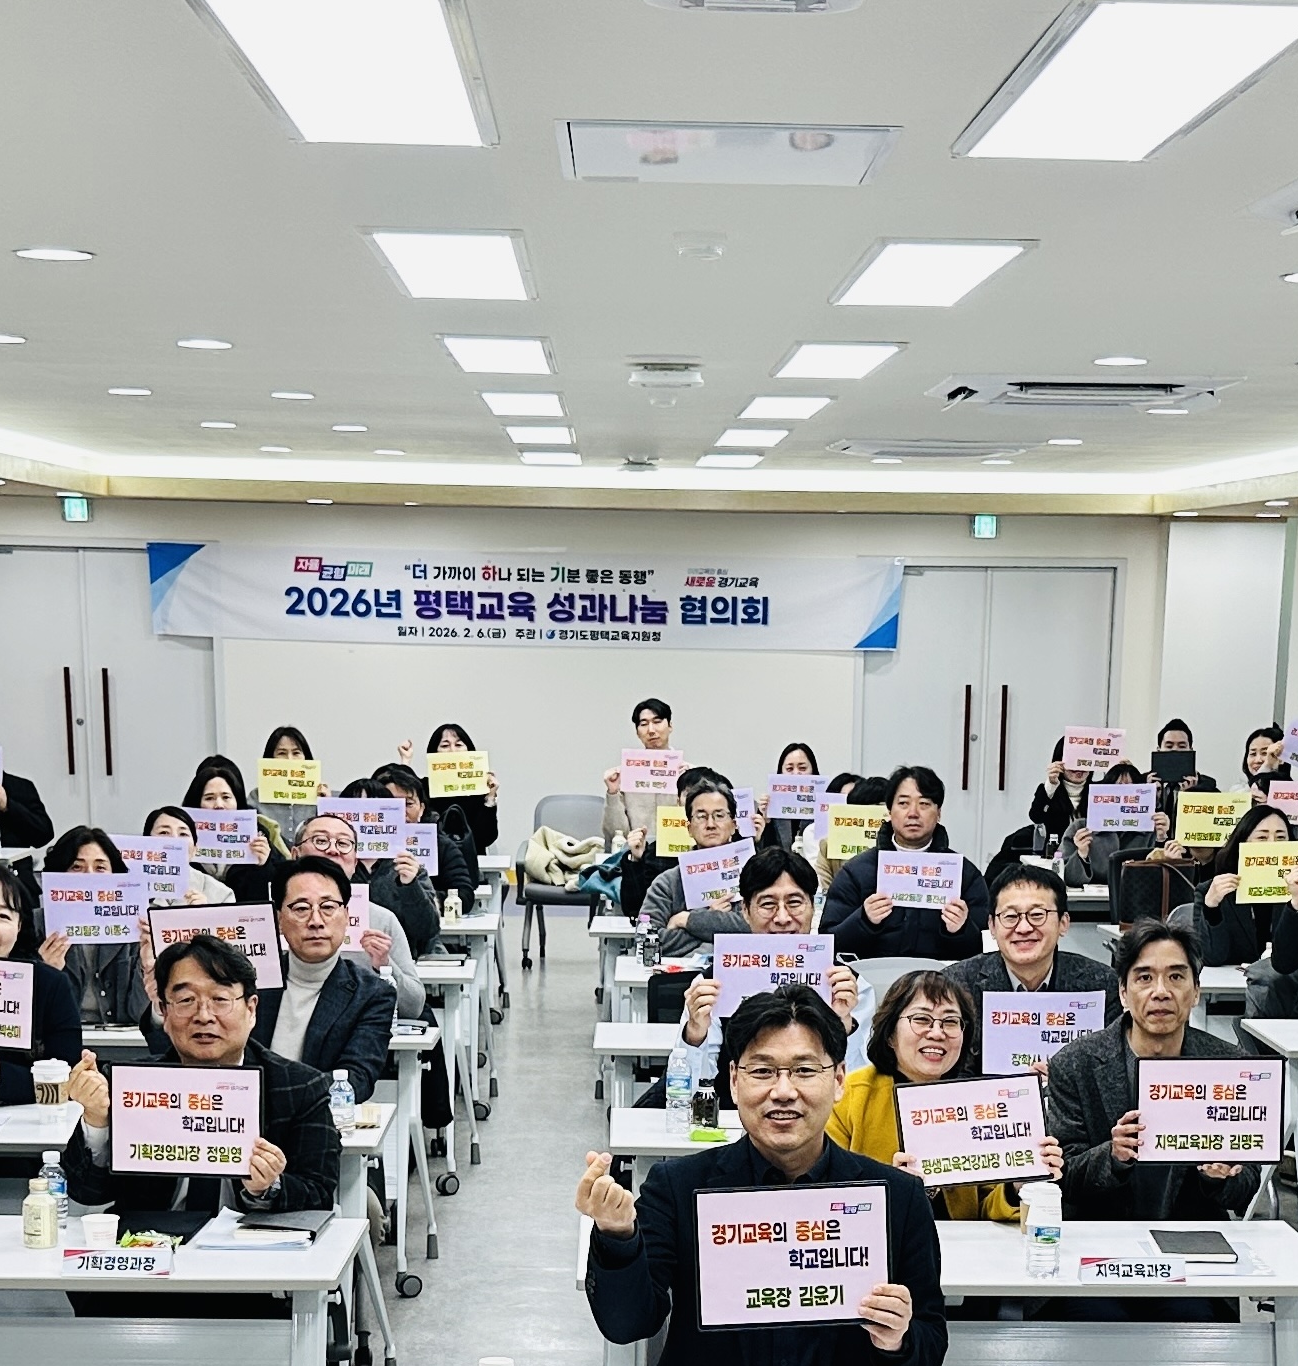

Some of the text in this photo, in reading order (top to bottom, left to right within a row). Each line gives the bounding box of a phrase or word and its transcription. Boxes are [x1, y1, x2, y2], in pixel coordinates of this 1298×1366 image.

[433, 566, 475, 581] 가까이
[482, 566, 511, 582] 하나
[517, 568, 545, 583] 되는
[551, 567, 580, 583] 기분
[586, 569, 613, 583] 좋은
[685, 576, 759, 588] 새로운 경기교육
[285, 586, 769, 625] 2026년 평택교육 성과나눔 협의회
[398, 626, 418, 637] 일자
[429, 627, 460, 638] 2026.
[515, 629, 536, 639] 주관
[559, 630, 661, 641] 경기도평택교육지원청
[51, 890, 123, 902] 경기교육의 중심은
[94, 905, 139, 916] 학교입니다!
[722, 954, 804, 968] 경기교육의 중심은
[992, 1012, 1076, 1026] 경기교육의 중심은
[122, 1091, 223, 1110] 경기교육의 중심은
[1150, 1084, 1247, 1100] 경기교육의 중심은
[911, 1102, 1008, 1125] 경기교육의 중심은
[1206, 1106, 1267, 1121] 학교입니다!
[182, 1116, 244, 1133] 학교입니다!
[971, 1122, 1031, 1141] 학교입니다!
[1155, 1134, 1224, 1150] 지역교육과장
[130, 1143, 200, 1161] 기획경영과장
[921, 1155, 1000, 1174] 평생교육건강과장
[712, 1219, 841, 1245] 경기교육의 중심은
[77, 1254, 156, 1272] 기획경영과장
[789, 1247, 869, 1269] 학교입니다!
[1096, 1264, 1171, 1278] 지역교육과장
[746, 1285, 844, 1309] 교육장 김윤기
